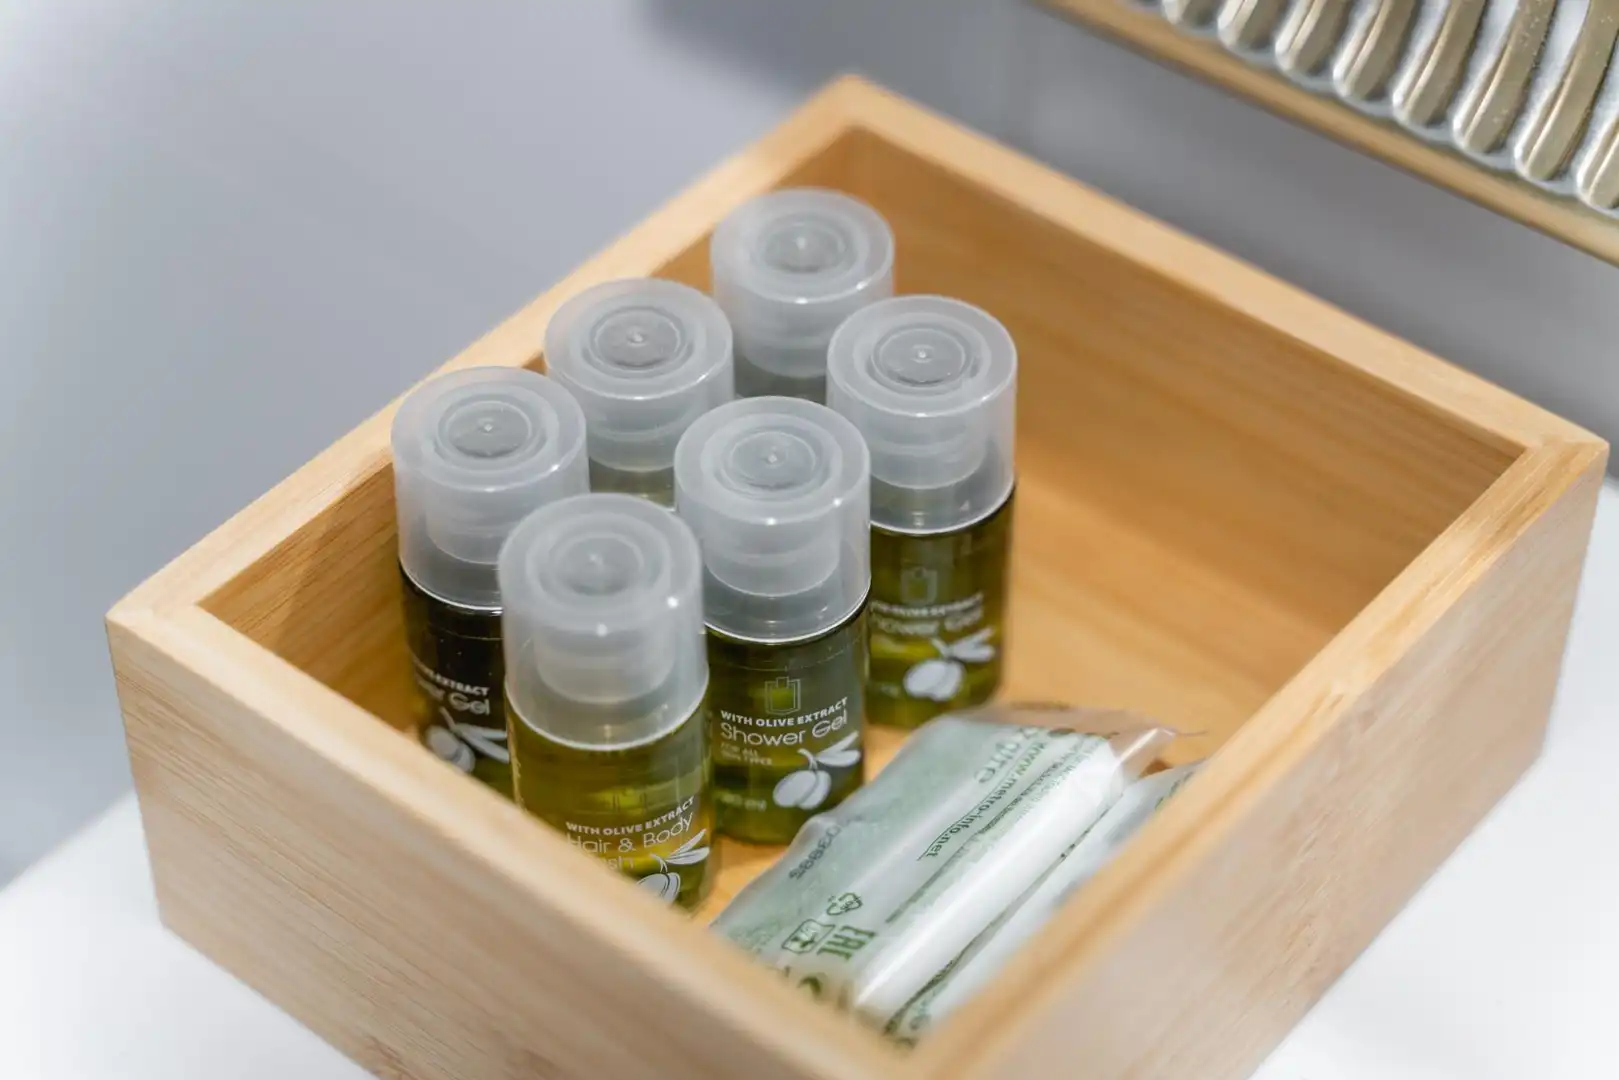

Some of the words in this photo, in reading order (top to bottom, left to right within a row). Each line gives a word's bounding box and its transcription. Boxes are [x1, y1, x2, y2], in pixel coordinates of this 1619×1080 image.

[449, 691, 490, 716] Gel
[720, 710, 753, 726] WITH
[755, 718, 795, 728] OLIVE
[797, 696, 848, 725] EXTRACT
[720, 722, 806, 746] Shower
[812, 709, 847, 738] Gel
[566, 821, 600, 835] WITH
[602, 823, 643, 836] OLIVE
[645, 796, 695, 829] EXTRACT
[924, 739, 1048, 858] www.metro-info.net
[566, 832, 612, 853] Hair
[618, 838, 636, 853] &
[643, 812, 694, 848] Body
